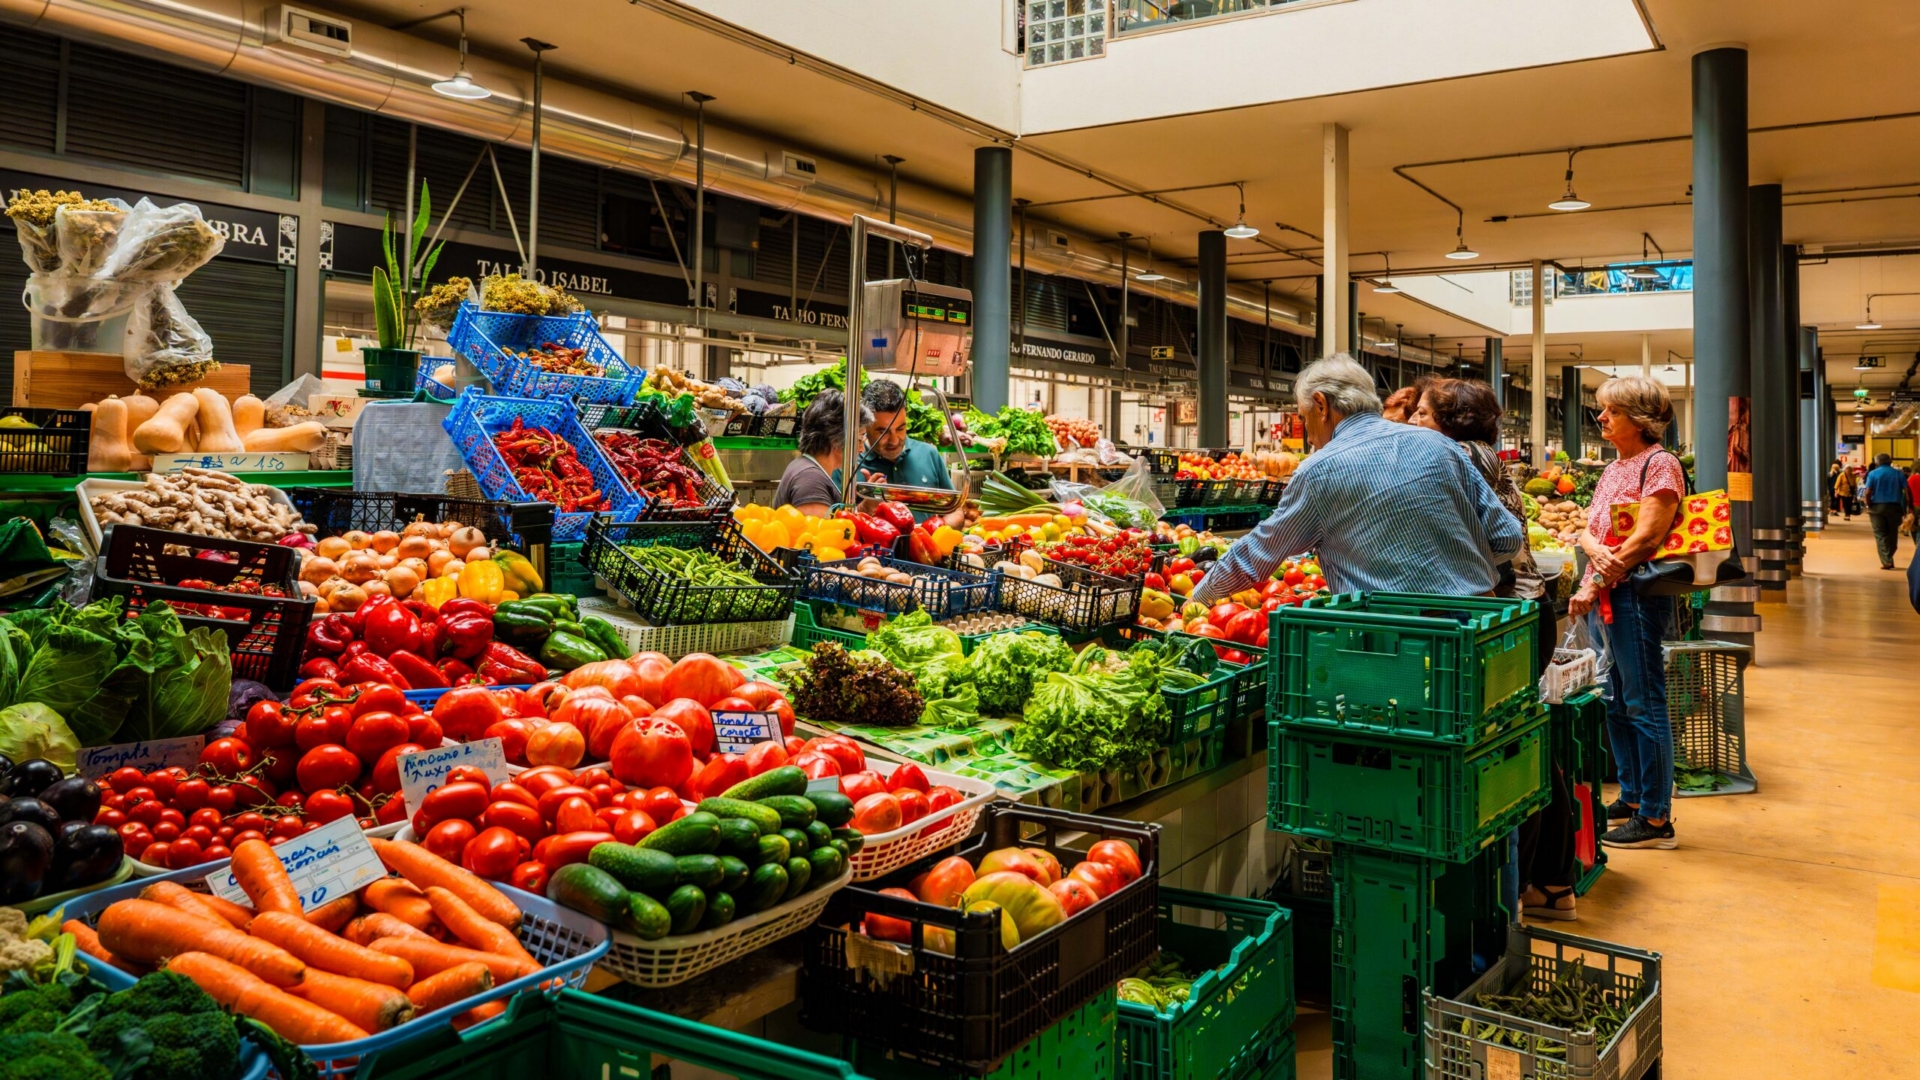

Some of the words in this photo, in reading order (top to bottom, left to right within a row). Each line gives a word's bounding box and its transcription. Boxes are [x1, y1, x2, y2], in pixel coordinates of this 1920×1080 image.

[551, 271, 612, 295] ISABEL
[1022, 343, 1062, 360] FERNANDO
[1063, 349, 1096, 364] GERARDO
